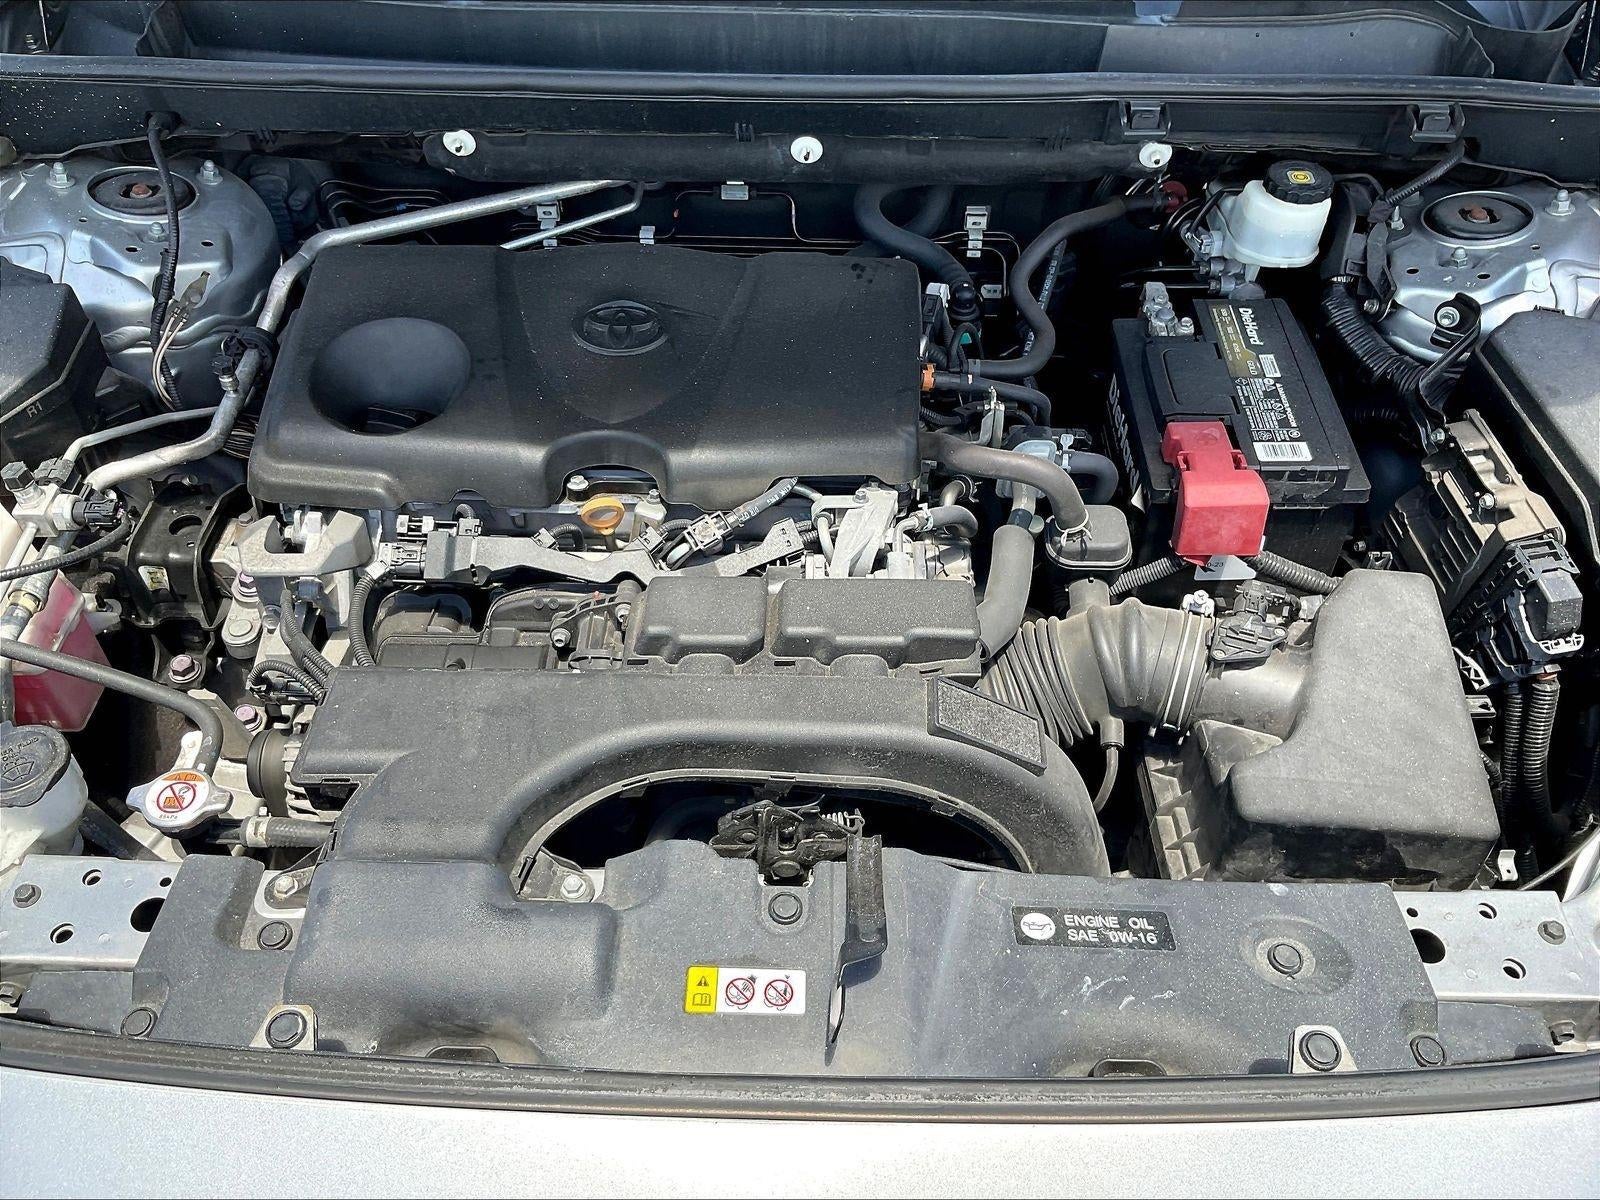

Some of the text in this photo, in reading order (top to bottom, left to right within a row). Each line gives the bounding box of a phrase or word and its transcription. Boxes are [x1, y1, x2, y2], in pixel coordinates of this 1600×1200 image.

[1238, 307, 1264, 346] DieHard
[1246, 360, 1258, 376] GOLD
[26, 401, 43, 418] R1
[1108, 373, 1140, 495] DieHard
[17, 736, 39, 750] FLUID
[1063, 914, 1155, 931] ENGINE OIL
[1067, 929, 1158, 945] SAE 0W-16
